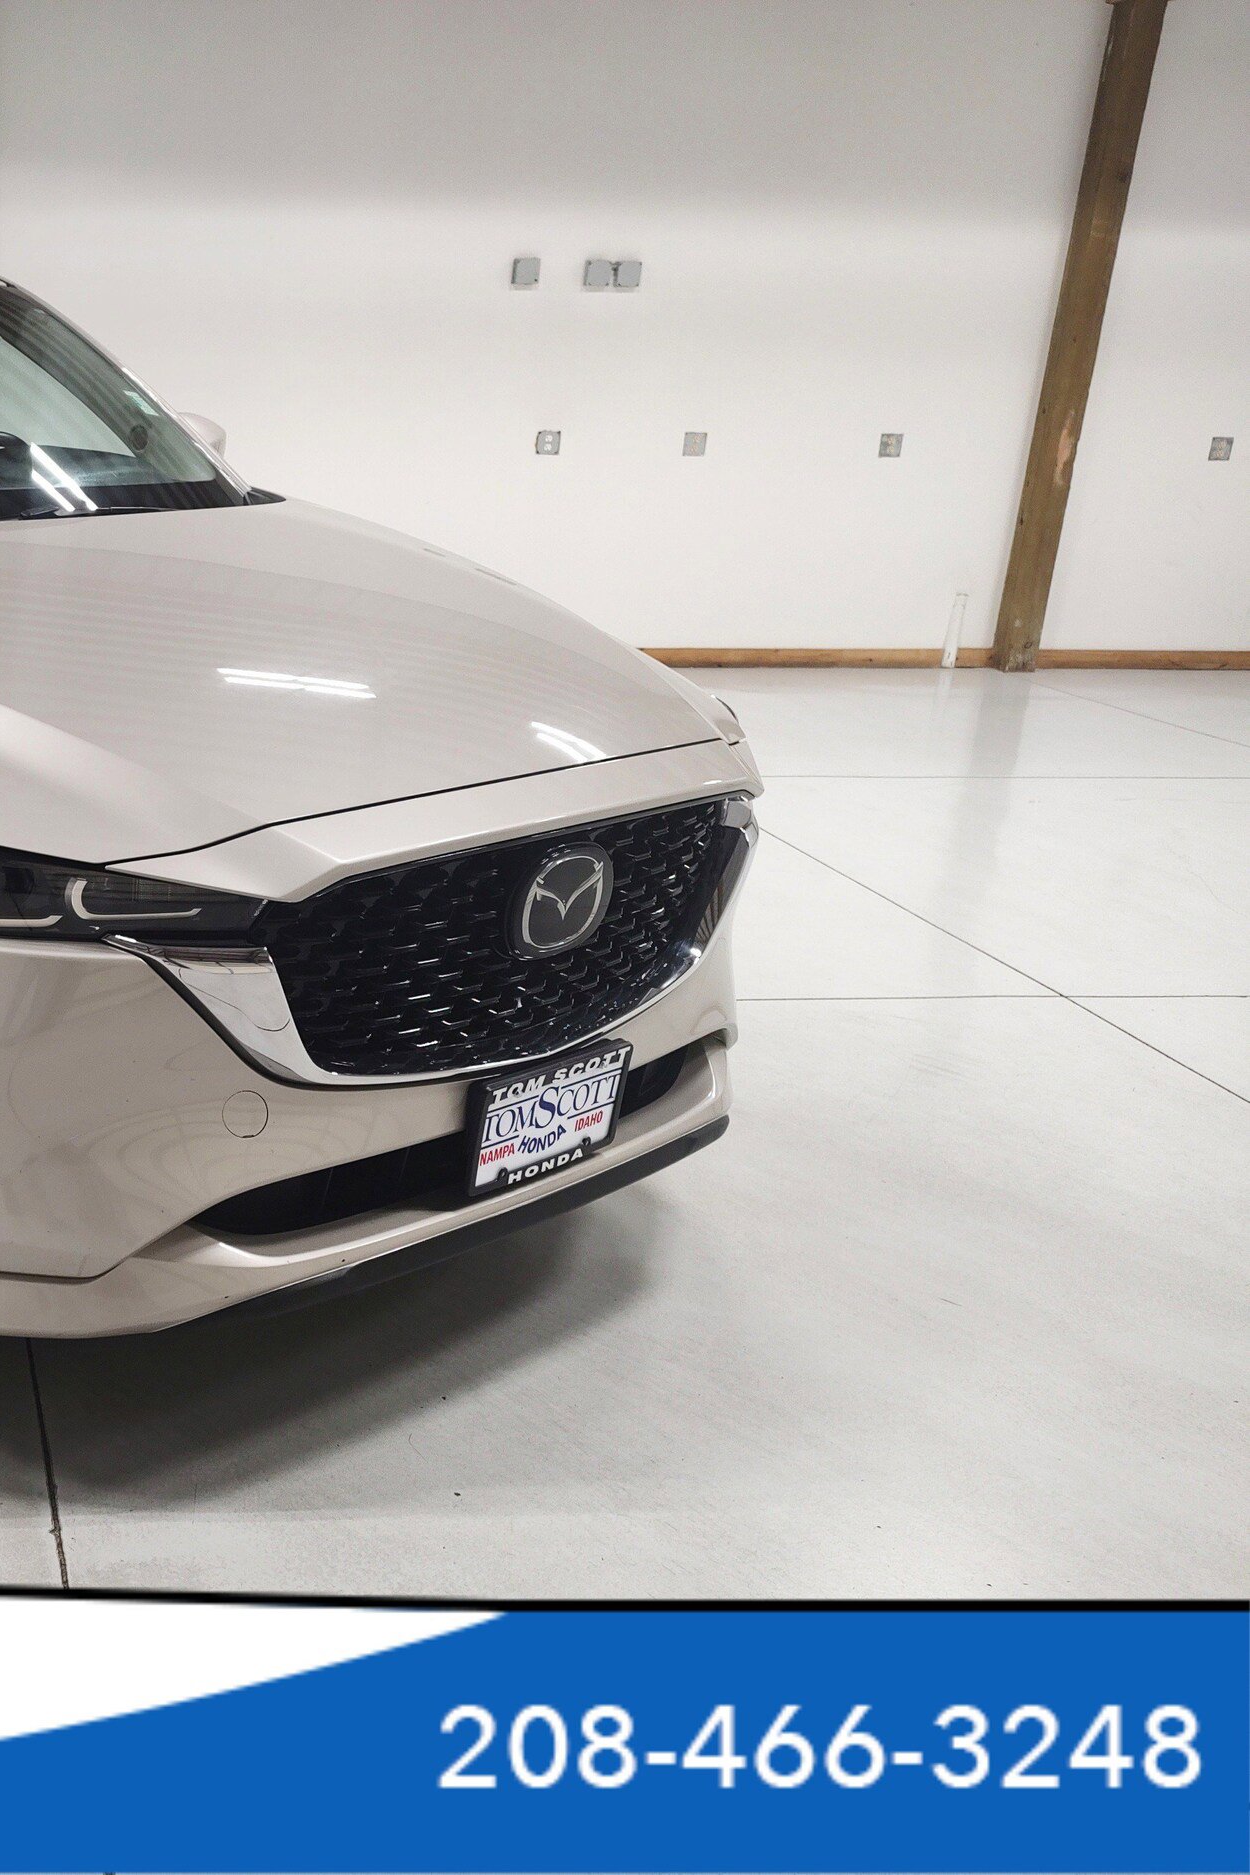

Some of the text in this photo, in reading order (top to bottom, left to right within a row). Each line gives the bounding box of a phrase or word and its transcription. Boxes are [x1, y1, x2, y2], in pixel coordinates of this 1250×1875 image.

[491, 1046, 631, 1106] TOM SCOTT
[574, 1110, 603, 1132] IDAHO
[517, 1124, 567, 1154] HONDA
[479, 1143, 515, 1166] NAMPA
[508, 1148, 583, 1184] HONDA
